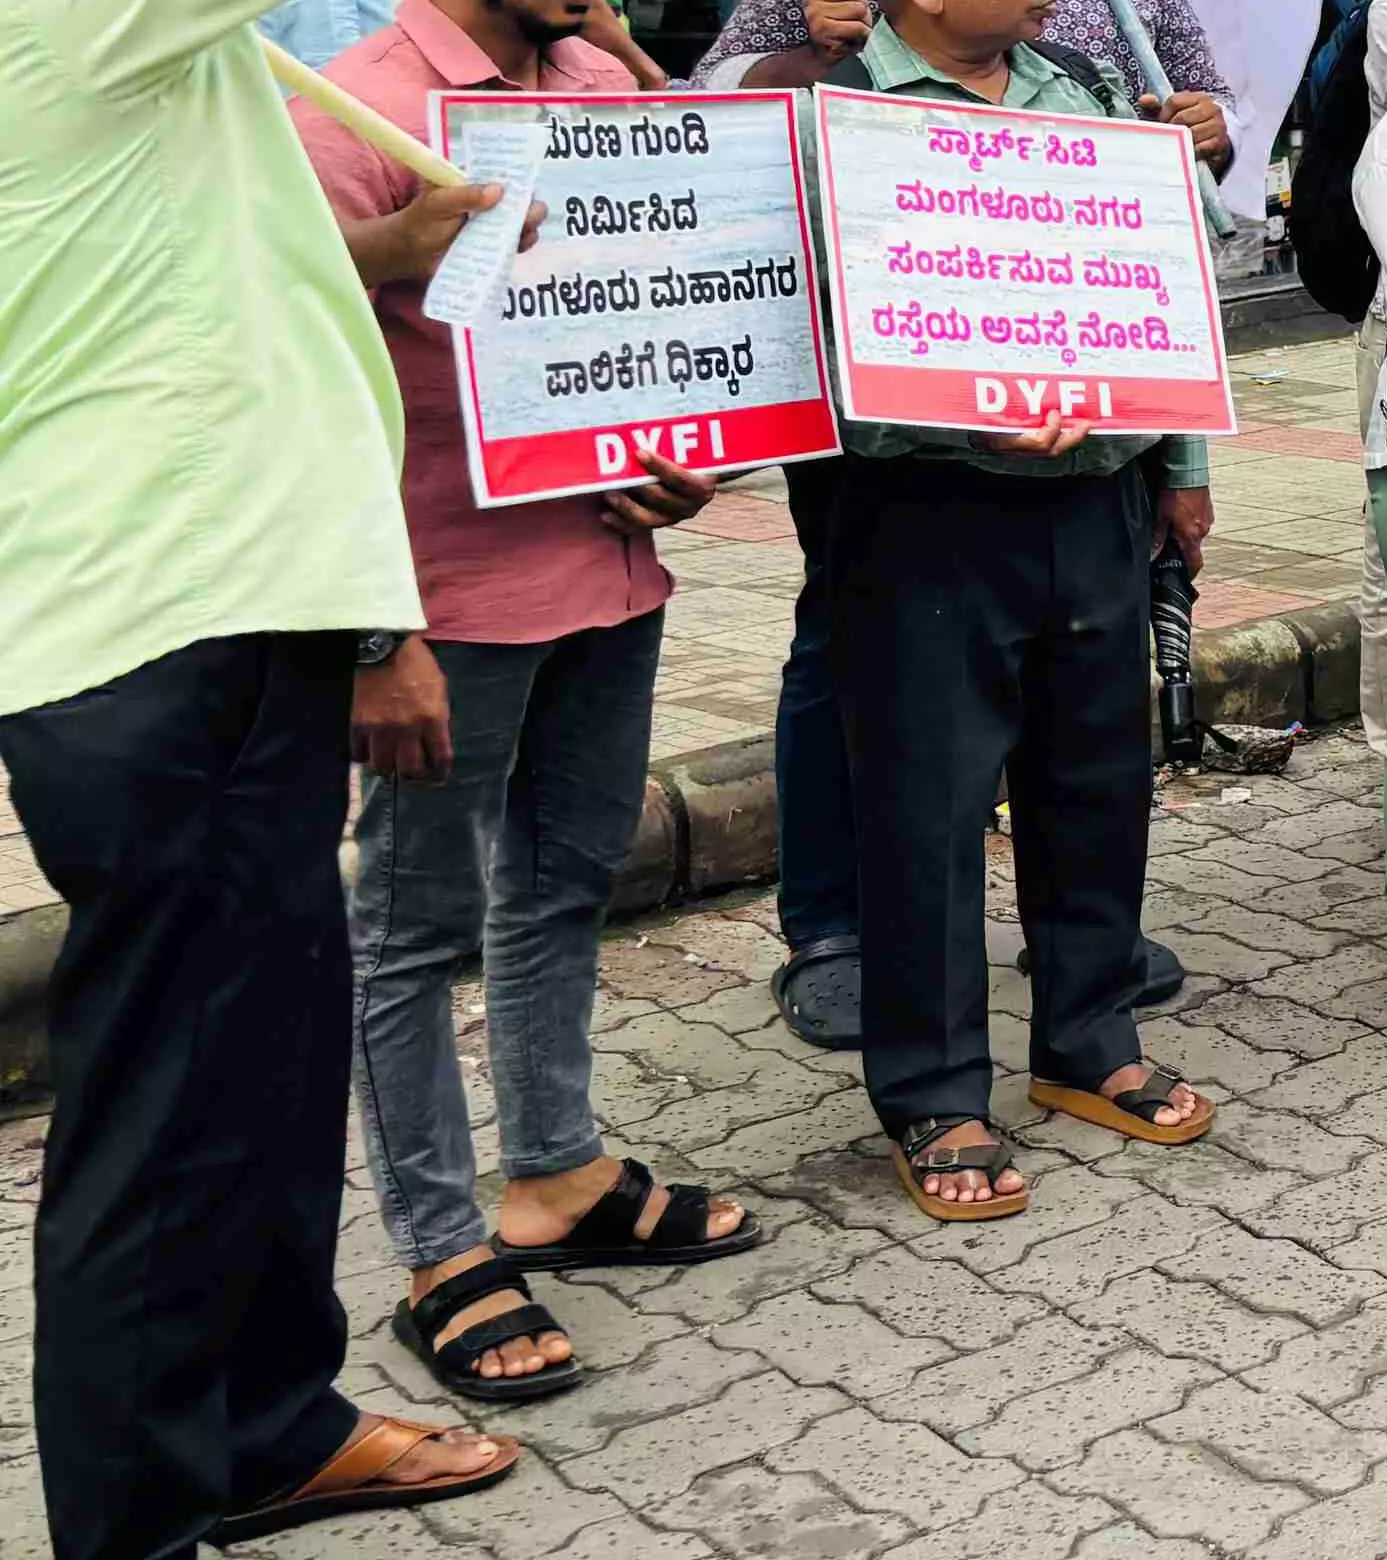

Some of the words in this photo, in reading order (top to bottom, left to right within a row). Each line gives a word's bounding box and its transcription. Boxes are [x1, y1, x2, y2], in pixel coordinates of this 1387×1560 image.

[629, 110, 710, 157] ಗುಂಡಿ
[1045, 132, 1098, 167] ಸಿಟಿ
[895, 179, 1065, 225] ಮಂಗಳೂರು
[1073, 193, 1144, 231] ನಗರ
[648, 255, 799, 310] ಮಹಾನಗರ
[1082, 254, 1171, 308] ಮುಖ್ಯ
[871, 300, 972, 356] ರಸ್ತೆಯ
[980, 309, 1078, 368] ಅವಸ್ಥೆ
[543, 341, 659, 399] ಪಾಲಿಕೆಗೆ
[666, 335, 755, 397] ಧಿಕ್ಕಾರ
[974, 376, 1113, 418] DYFI
[594, 418, 726, 476] DYFI
